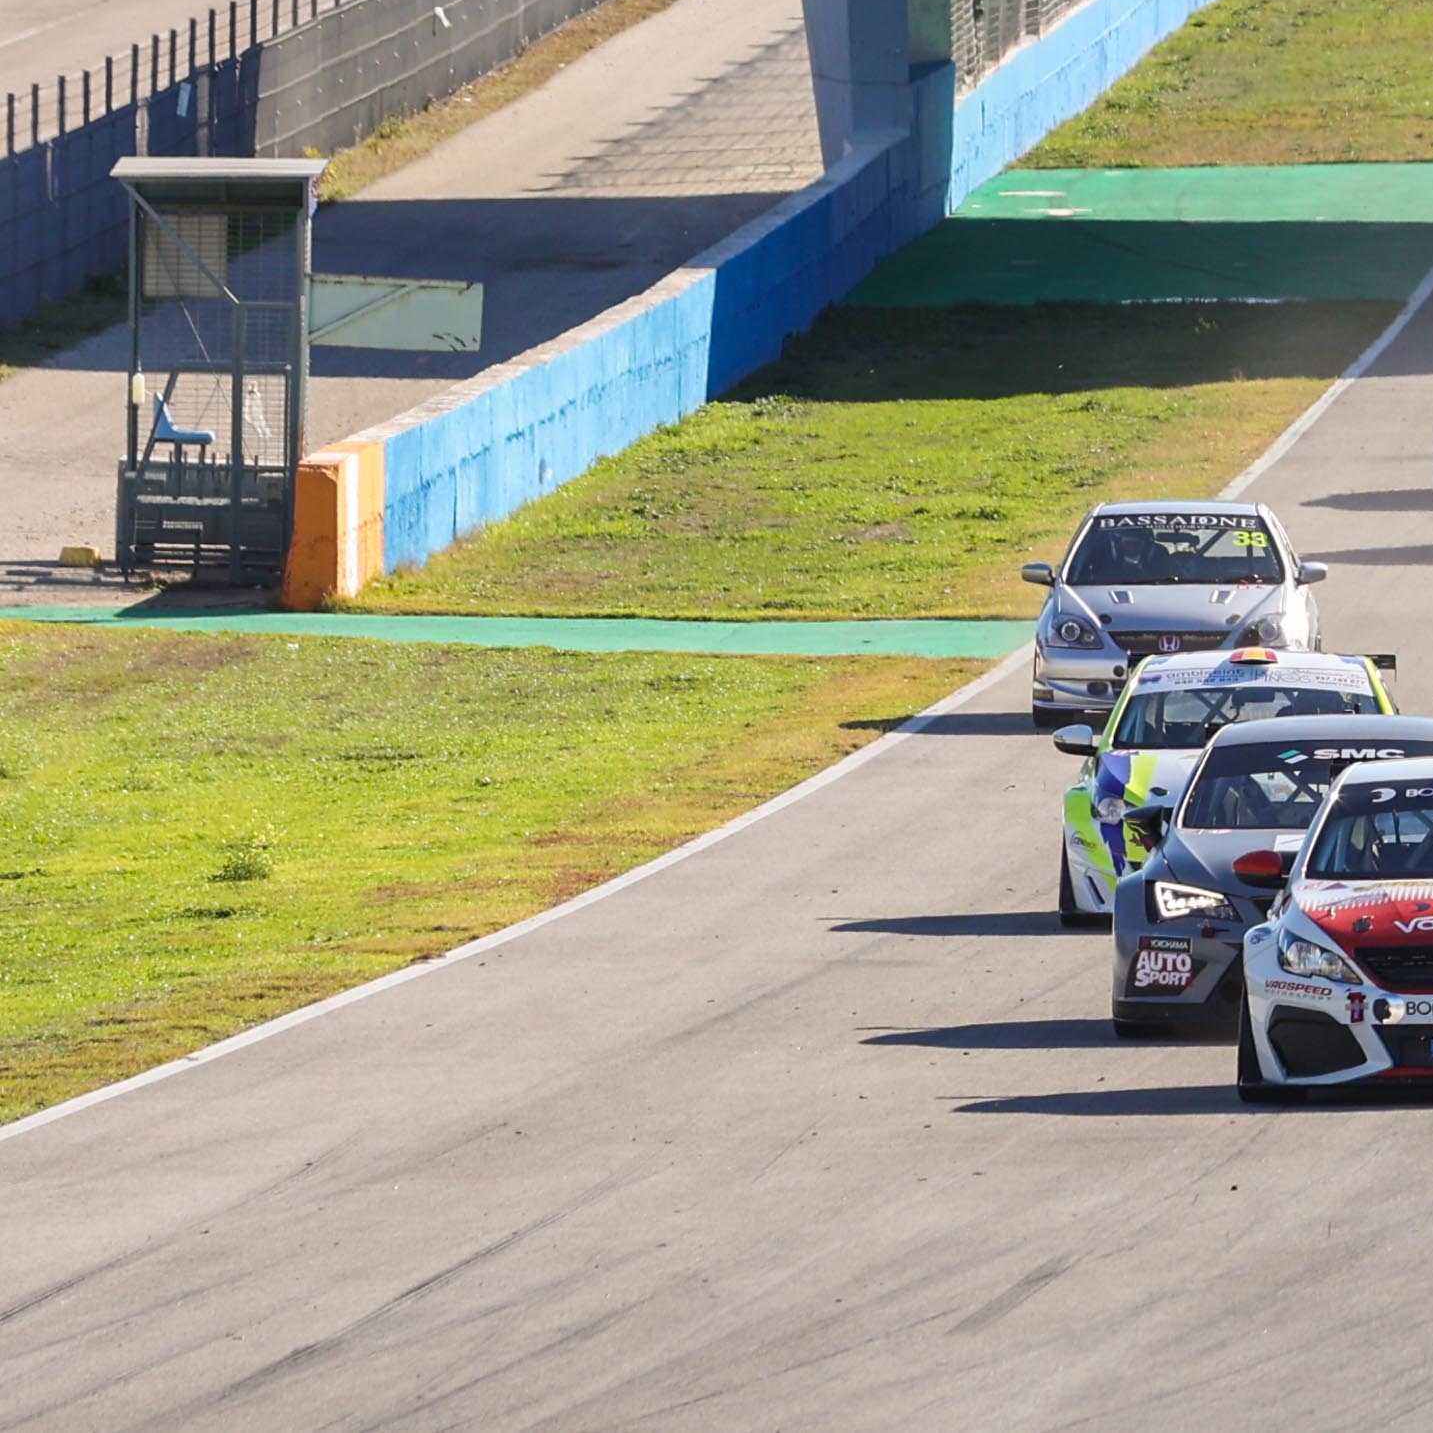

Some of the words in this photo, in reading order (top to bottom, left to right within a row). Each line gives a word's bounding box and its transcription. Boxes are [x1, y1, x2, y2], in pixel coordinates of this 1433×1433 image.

[1231, 531, 1270, 547] 33
[1312, 748, 1405, 760] SMC
[1136, 950, 1192, 972] AUTO
[1134, 969, 1191, 987] SPORT
[1264, 979, 1333, 996] VAGSPEED
